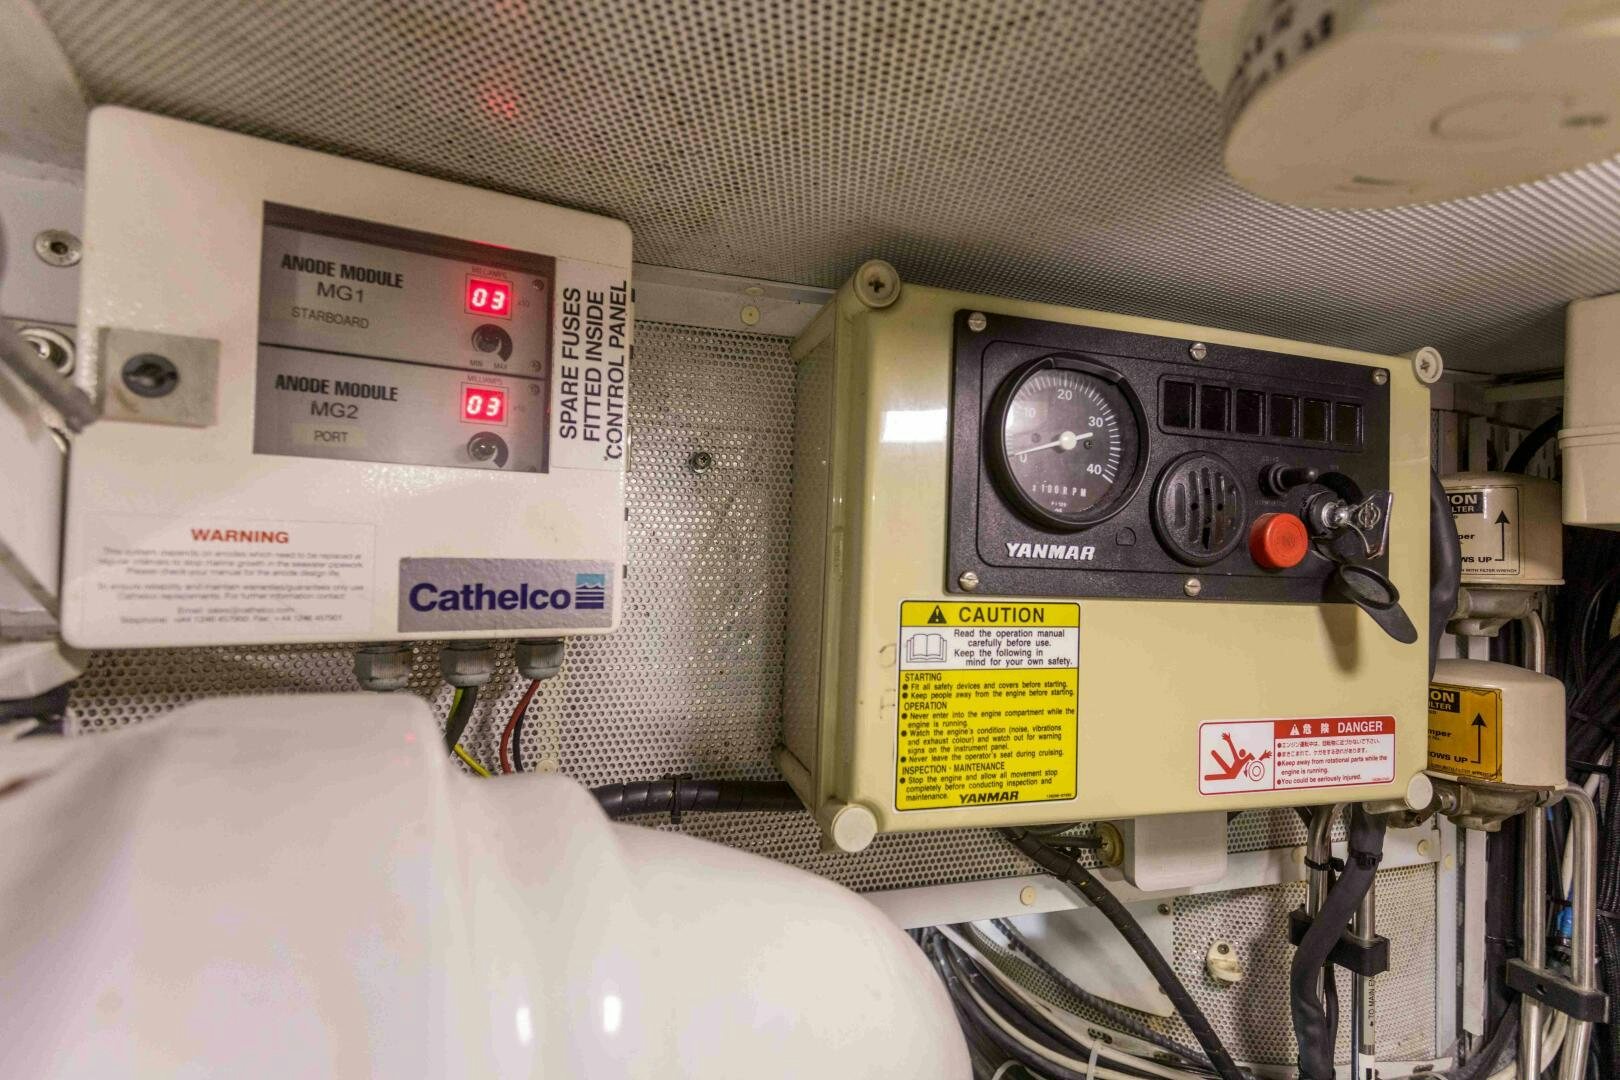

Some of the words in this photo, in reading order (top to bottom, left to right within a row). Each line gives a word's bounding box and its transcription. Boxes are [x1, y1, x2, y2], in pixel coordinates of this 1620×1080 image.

[281, 254, 338, 279] ANODE
[340, 264, 403, 289] MODULE
[316, 282, 364, 303] MG1
[472, 288, 506, 310] 03
[292, 306, 369, 329] STARBOARD
[609, 280, 626, 348] PANEL
[562, 288, 580, 360] FUSES
[586, 290, 604, 362] INSIDE
[274, 374, 330, 396] ANODE
[334, 382, 398, 402] MODULE
[1058, 388, 1072, 401] 20
[466, 395, 501, 416] 03
[560, 366, 579, 439] SPARE
[584, 368, 602, 442] FITTED
[606, 355, 624, 459] CONTROL
[311, 400, 358, 420] MG2
[1023, 406, 1036, 418] 10
[1088, 416, 1103, 428] 30
[314, 430, 348, 443] PORT
[1020, 454, 1028, 464] 0
[1086, 464, 1102, 476] 40
[192, 528, 288, 544] WARNING
[1006, 542, 1096, 560] YANMAR
[409, 582, 572, 612] Cathelco
[959, 607, 1044, 622] CAUTION
[954, 629, 974, 637] Read
[996, 629, 1032, 639] operation
[1037, 629, 1065, 637] manual
[968, 639, 1002, 648] carefully
[954, 649, 974, 658] Keep
[996, 648, 1032, 658] following
[1048, 657, 1072, 666] safety.
[905, 673, 942, 681] STARTING
[904, 701, 947, 710] OPERATION
[1005, 709, 1044, 717] compartment
[1338, 721, 1382, 733] DANGER
[902, 765, 946, 775] INSPECTION
[954, 762, 1005, 772] MAINTENANCE
[960, 791, 1019, 804] YANMAR
[1368, 1008, 1374, 1018] TO
